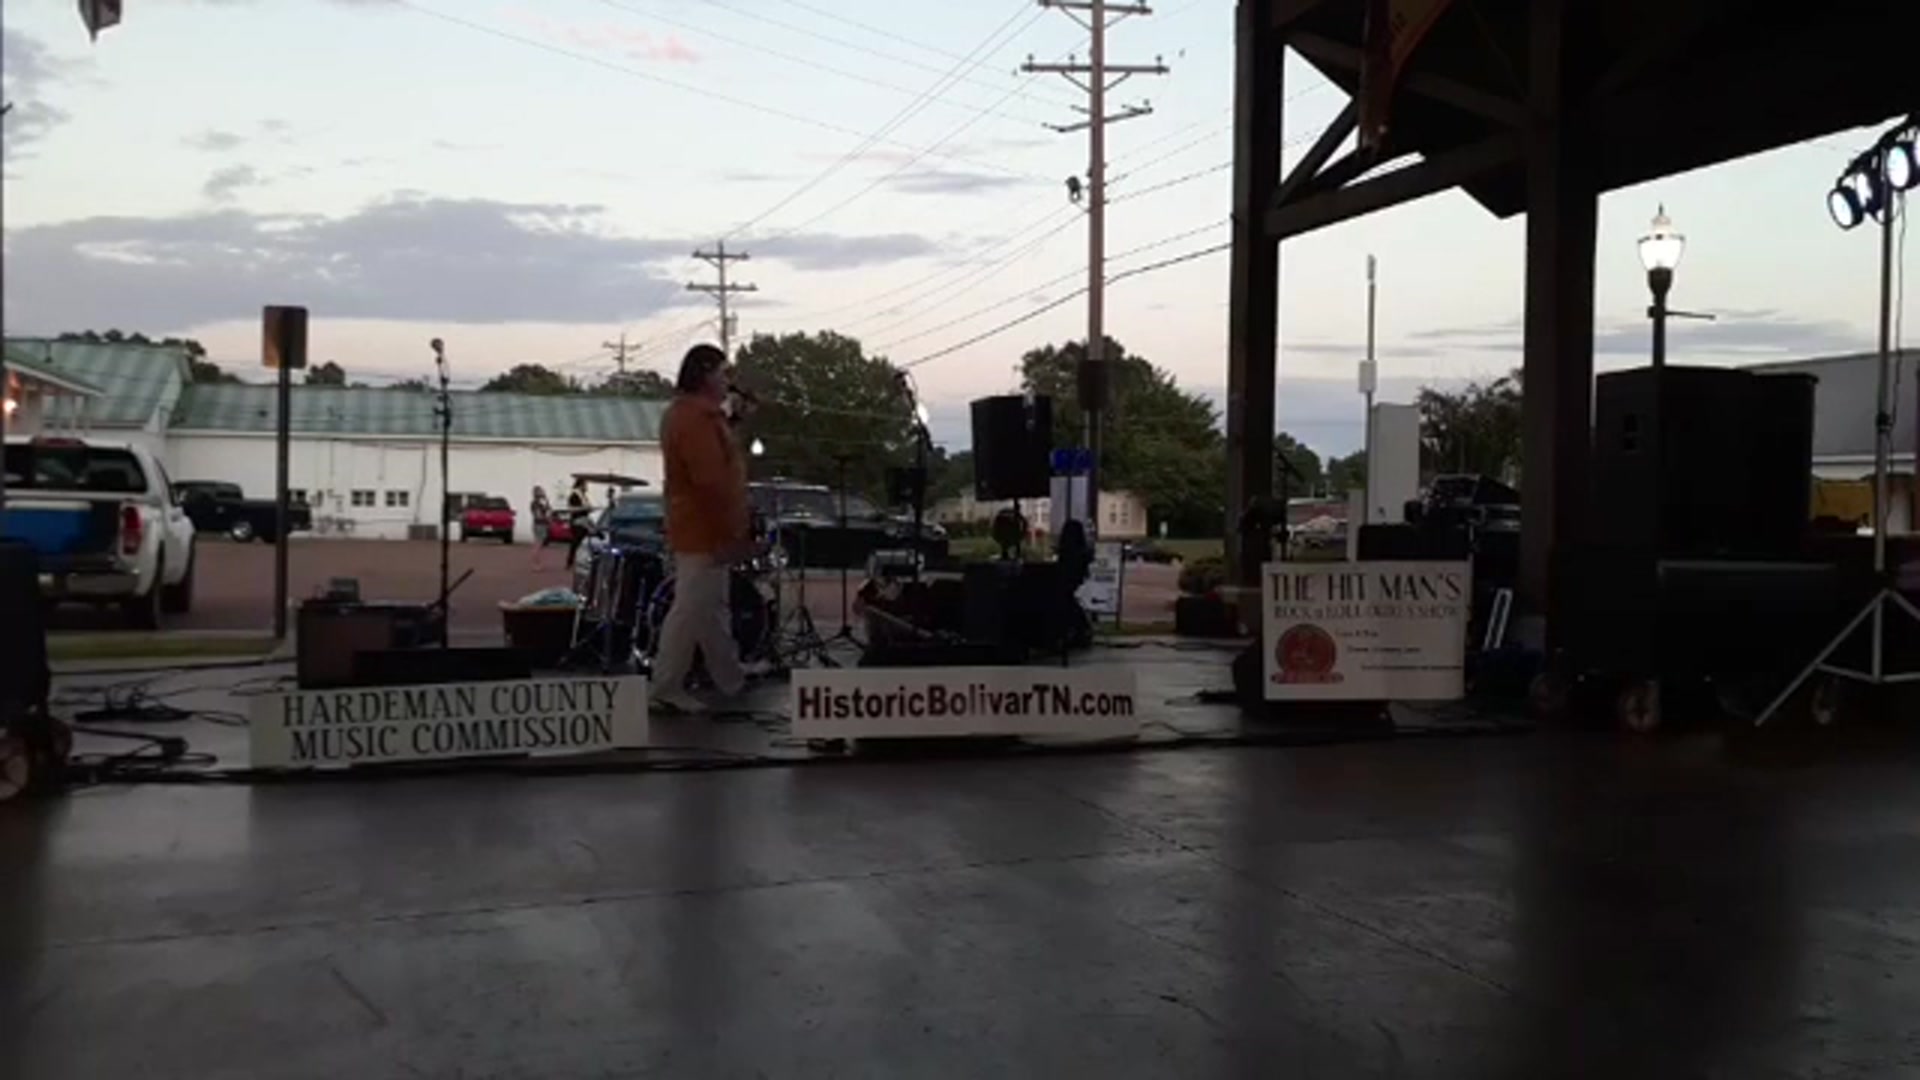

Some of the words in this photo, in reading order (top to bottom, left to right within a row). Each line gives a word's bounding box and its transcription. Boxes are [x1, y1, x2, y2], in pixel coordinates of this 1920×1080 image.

[1270, 573, 1317, 602] THE
[1328, 573, 1367, 601] HIT
[1380, 573, 1463, 601] MAN'S
[283, 686, 477, 727] HARDEMAN
[490, 681, 621, 716] COUNTY
[798, 684, 1135, 719] HistoricBolivarTN.com
[291, 725, 399, 762] MUSIC
[411, 714, 615, 755] COMMISSION
